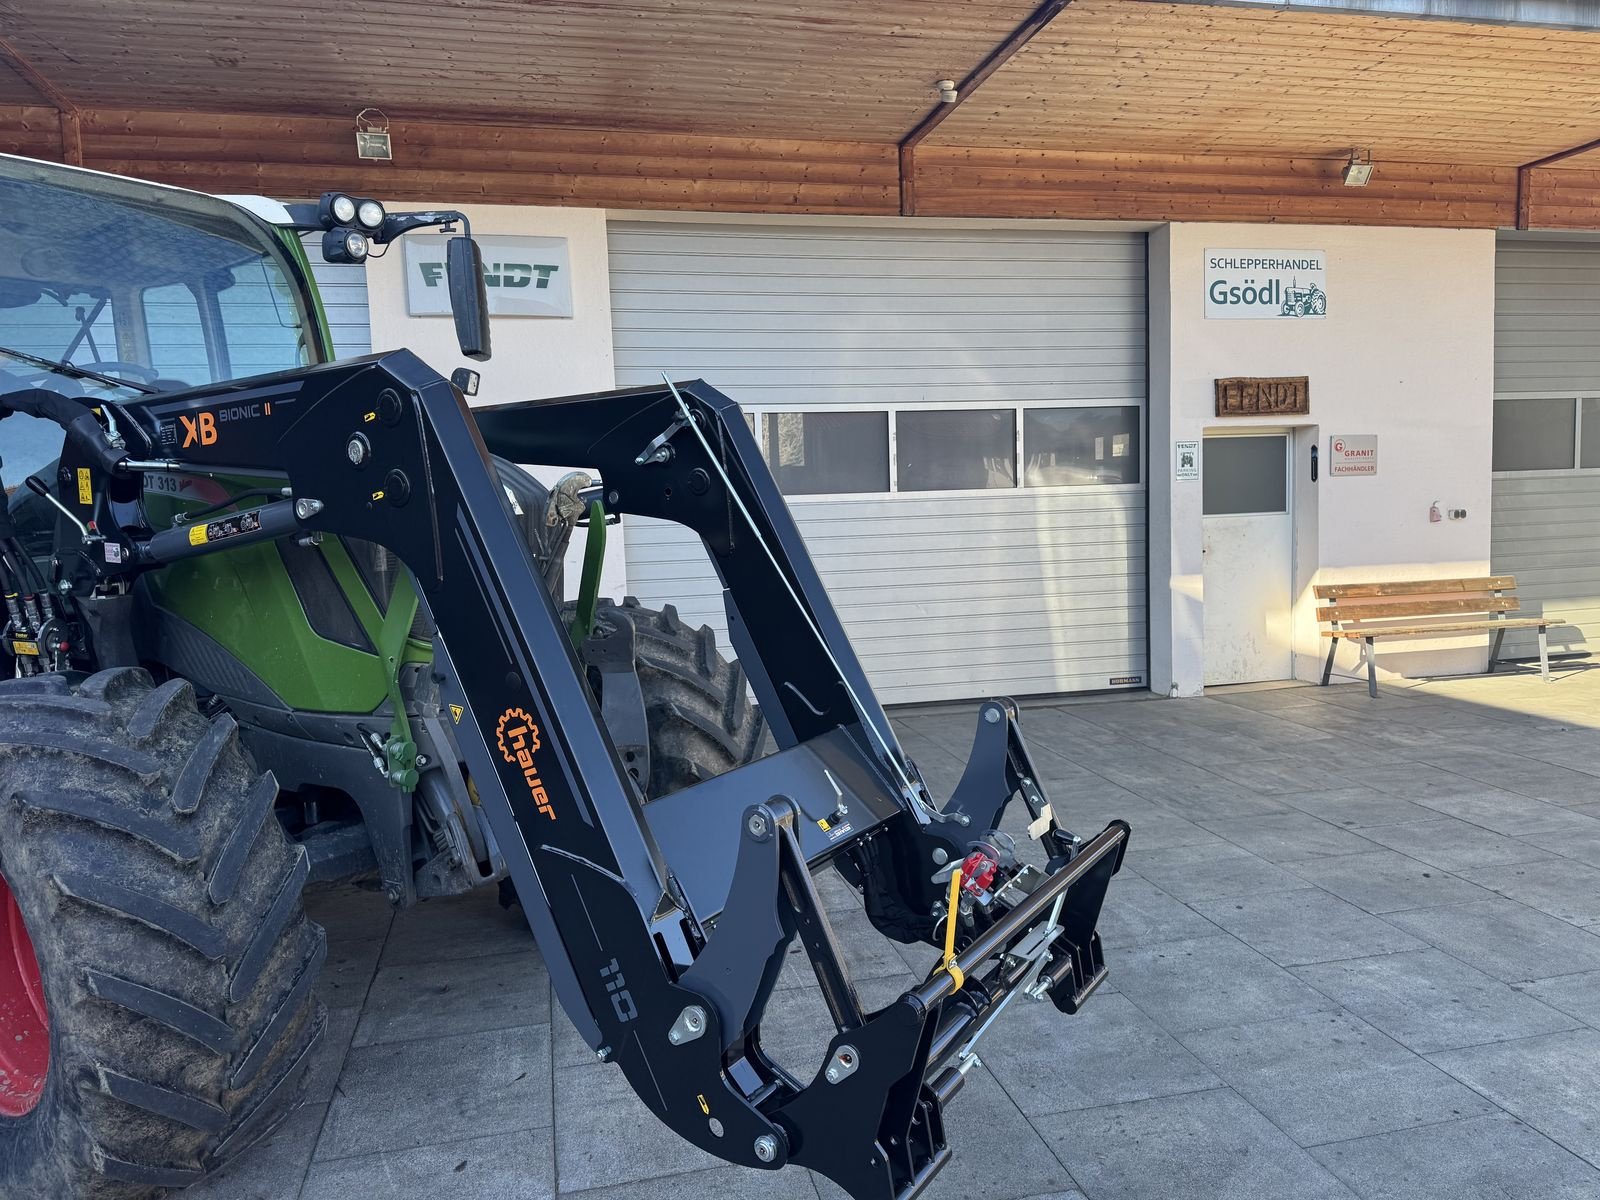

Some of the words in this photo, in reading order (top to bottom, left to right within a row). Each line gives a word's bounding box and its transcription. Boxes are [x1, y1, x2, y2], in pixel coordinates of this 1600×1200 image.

[418, 262, 559, 289] FNDT
[1209, 257, 1323, 271] SCHLEPPERHANDEL
[1209, 278, 1280, 305] Gsödl
[1222, 381, 1299, 411] FENDT
[179, 412, 218, 449] XB
[219, 404, 260, 422] BIONIC
[1344, 449, 1375, 457] GRANIT
[1334, 464, 1375, 473] FACHHÄNDLER
[157, 476, 177, 492] 313
[507, 725, 557, 820] hauer
[600, 957, 638, 1023] 110
